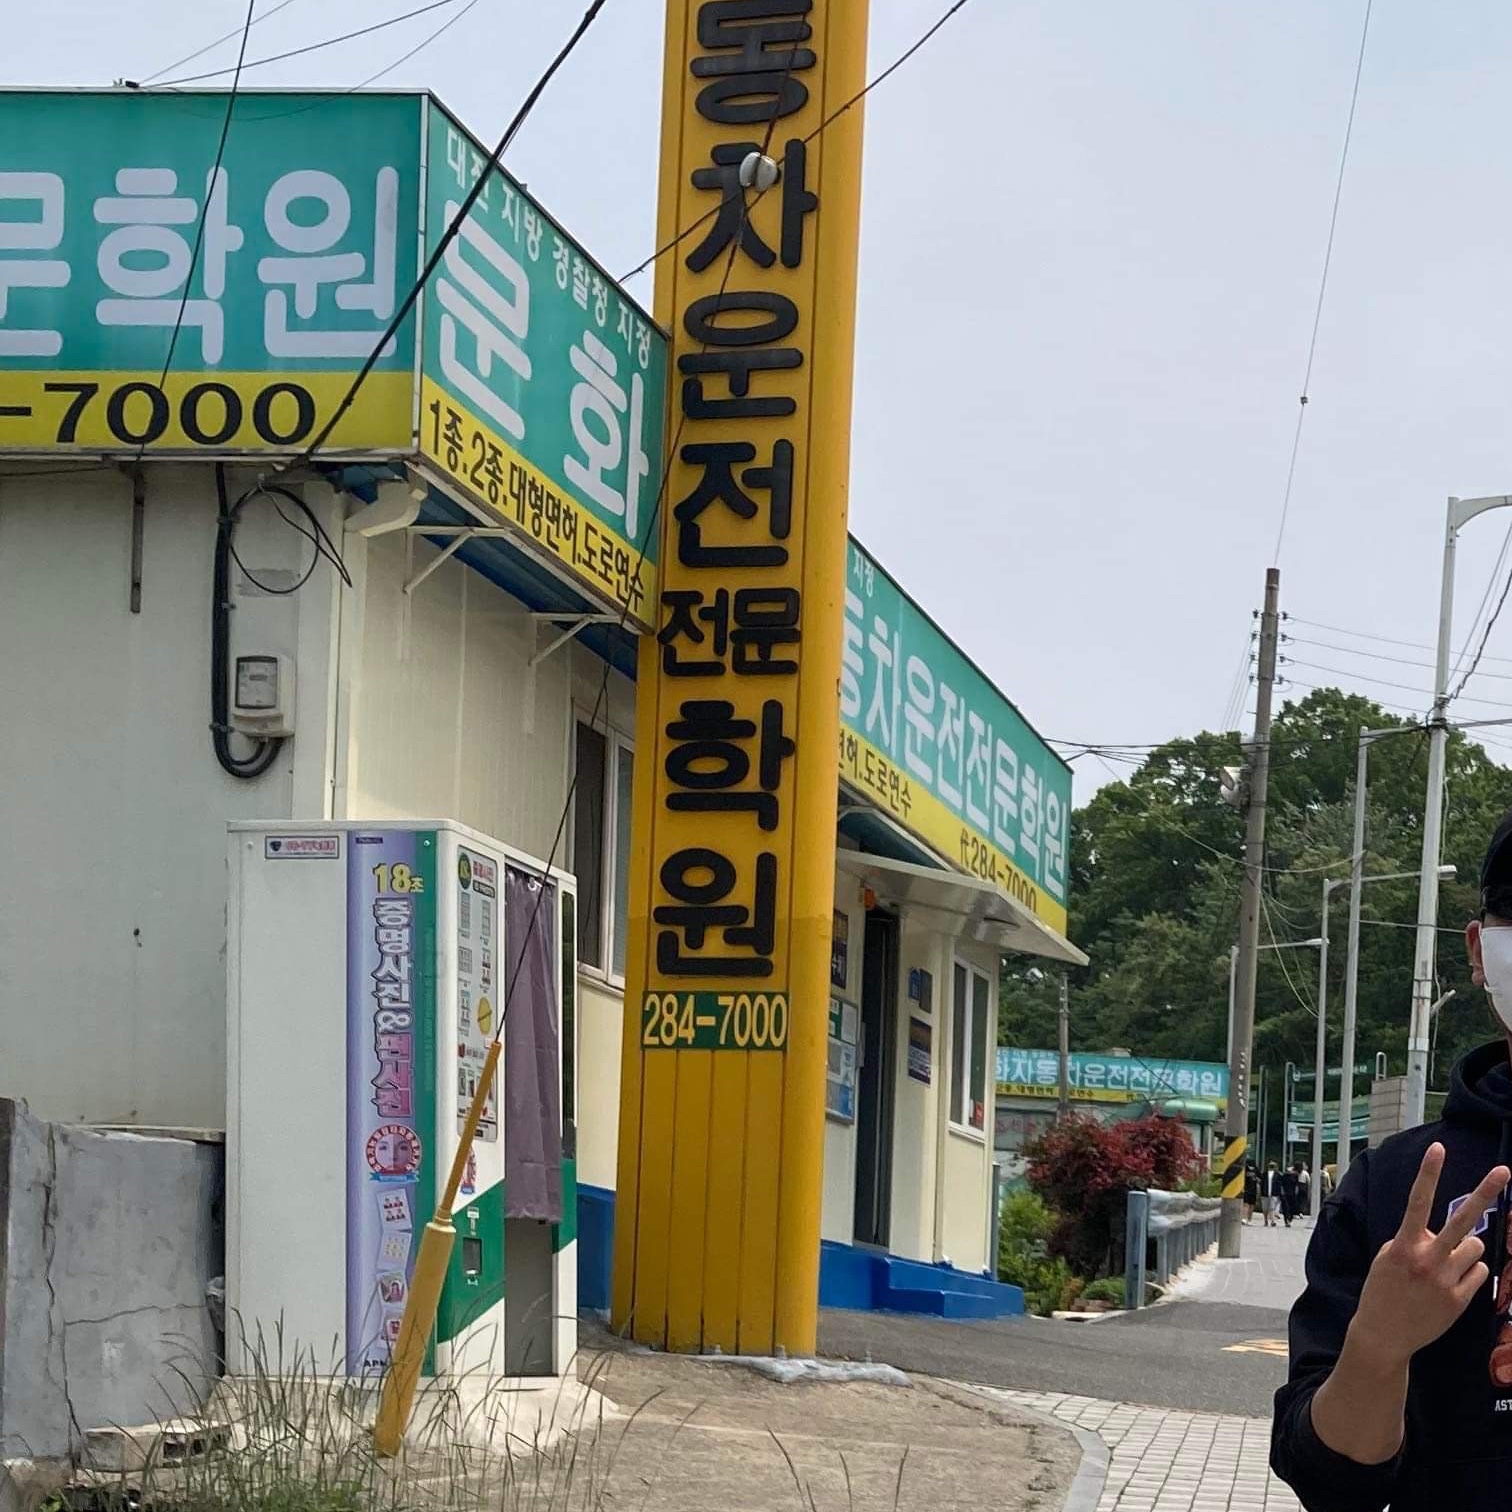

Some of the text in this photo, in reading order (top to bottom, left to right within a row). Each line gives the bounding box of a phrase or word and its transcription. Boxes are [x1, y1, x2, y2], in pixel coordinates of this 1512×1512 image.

[501, 182, 543, 262] 지방
[551, 236, 609, 328] 경찰청
[617, 301, 650, 370] 지정
[658, 586, 802, 677] 전문
[652, 699, 796, 979] 학원
[642, 994, 788, 1049] 284-7000
